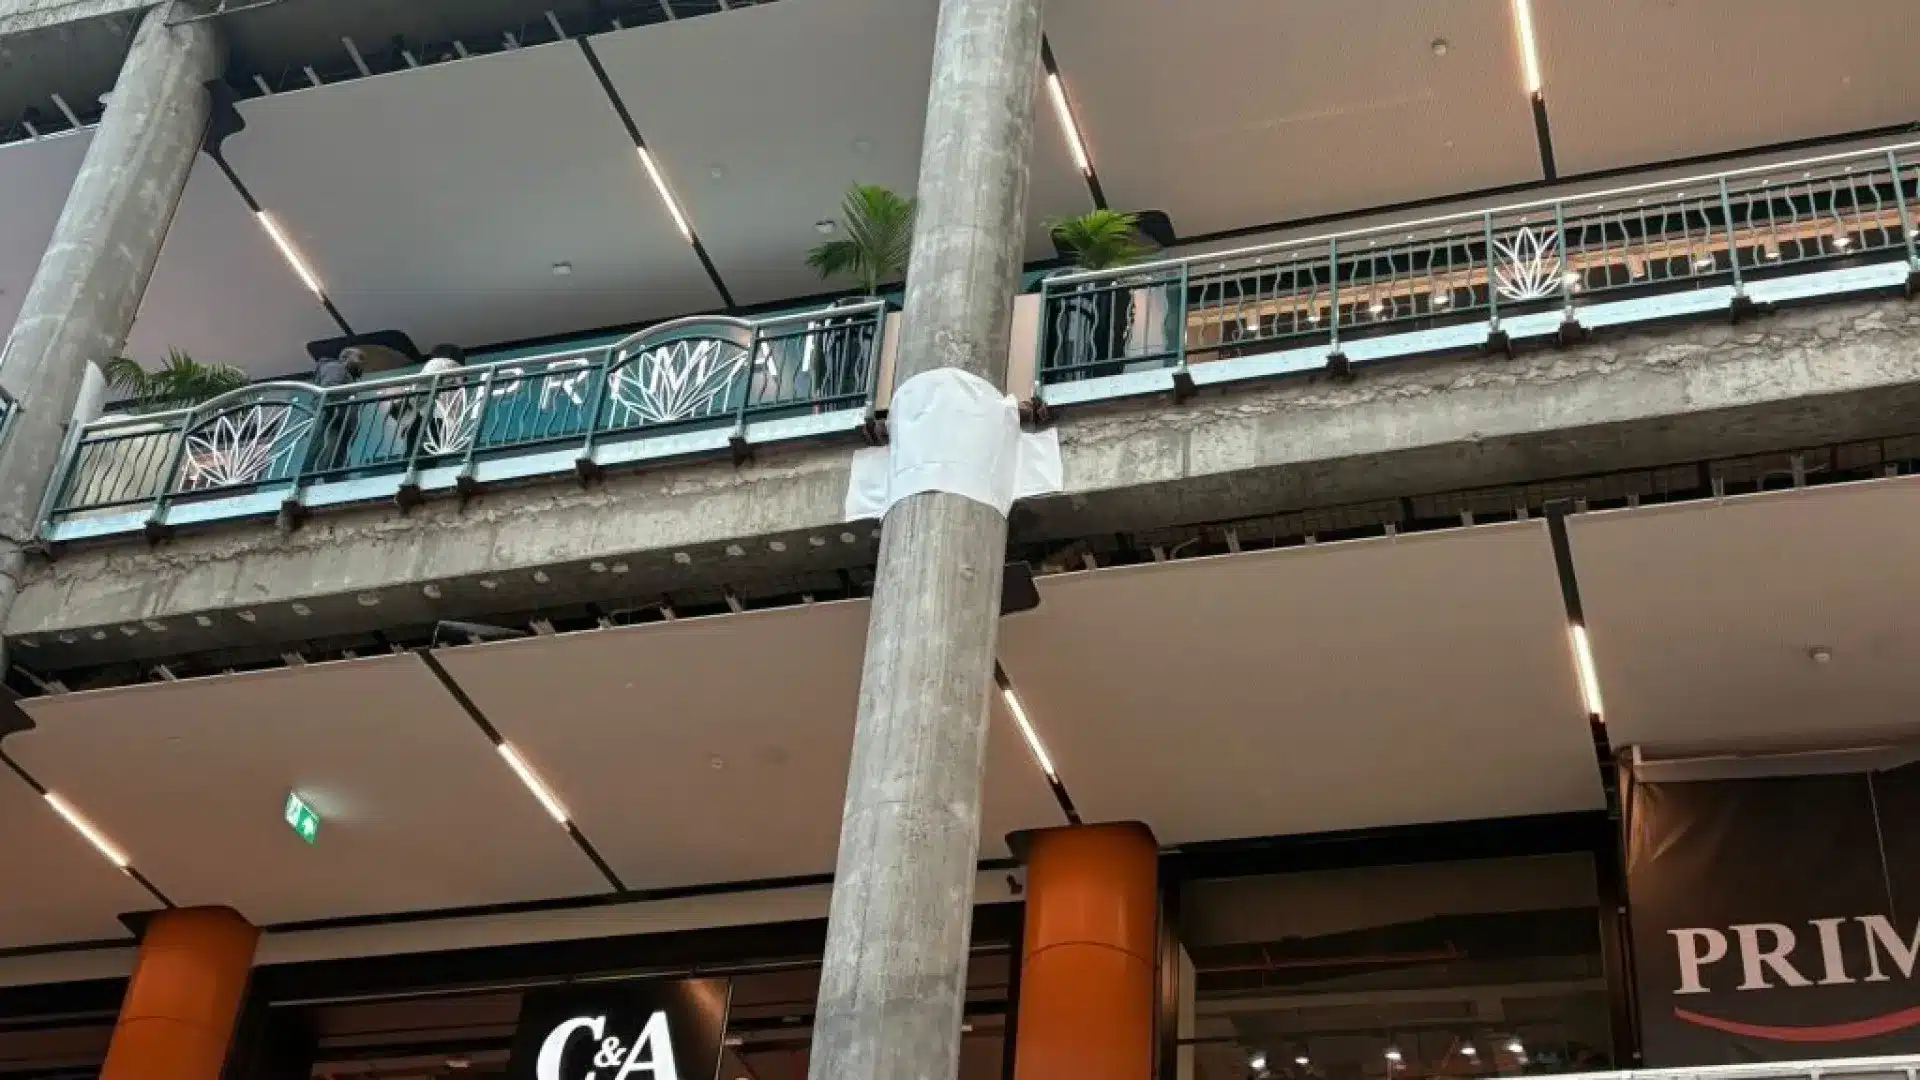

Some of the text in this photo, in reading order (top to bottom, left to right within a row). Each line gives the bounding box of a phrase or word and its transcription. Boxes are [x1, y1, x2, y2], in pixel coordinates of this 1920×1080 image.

[472, 319, 822, 421] PRIMA
[1667, 914, 1920, 995] PRIM
[536, 1010, 678, 1080] C&A
